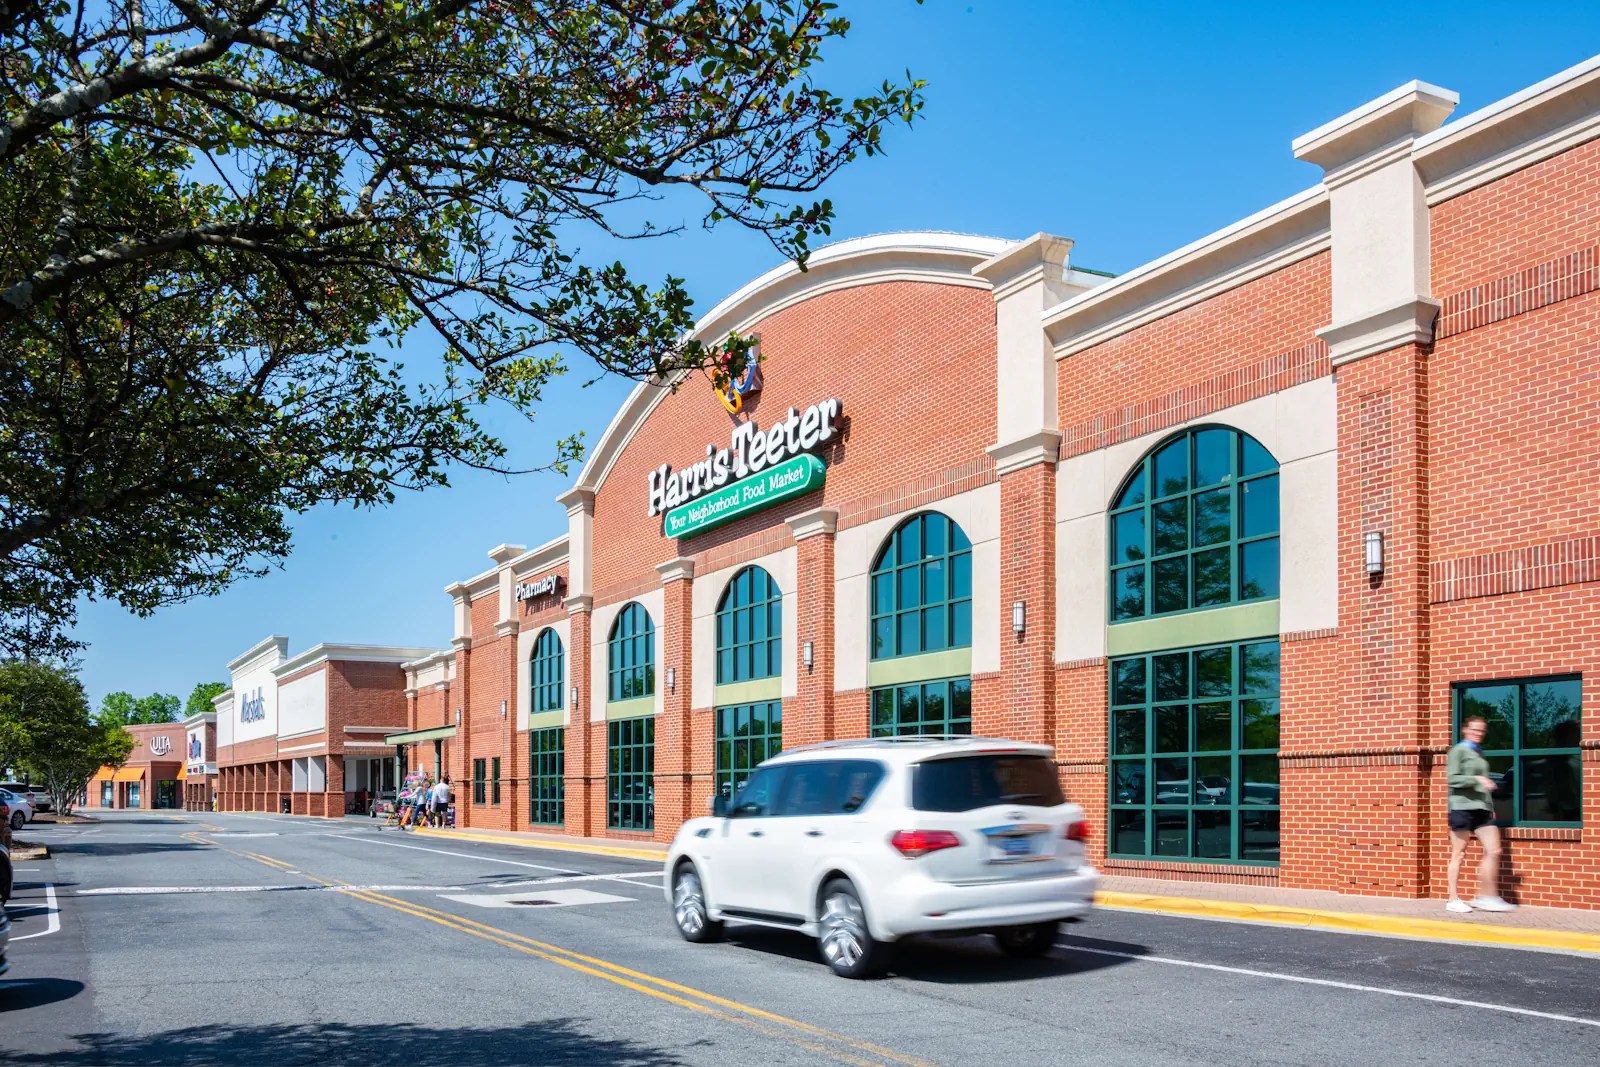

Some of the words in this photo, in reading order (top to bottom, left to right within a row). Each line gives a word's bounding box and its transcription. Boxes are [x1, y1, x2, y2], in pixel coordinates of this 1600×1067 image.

[648, 444, 729, 517] Harris
[731, 398, 837, 478] Teeter
[670, 516, 686, 531] Your
[688, 489, 739, 523] Neighborhood
[743, 479, 766, 502] Food
[769, 465, 804, 492] Market
[515, 575, 557, 602] Pharmacy
[151, 736, 171, 751] ULTA
